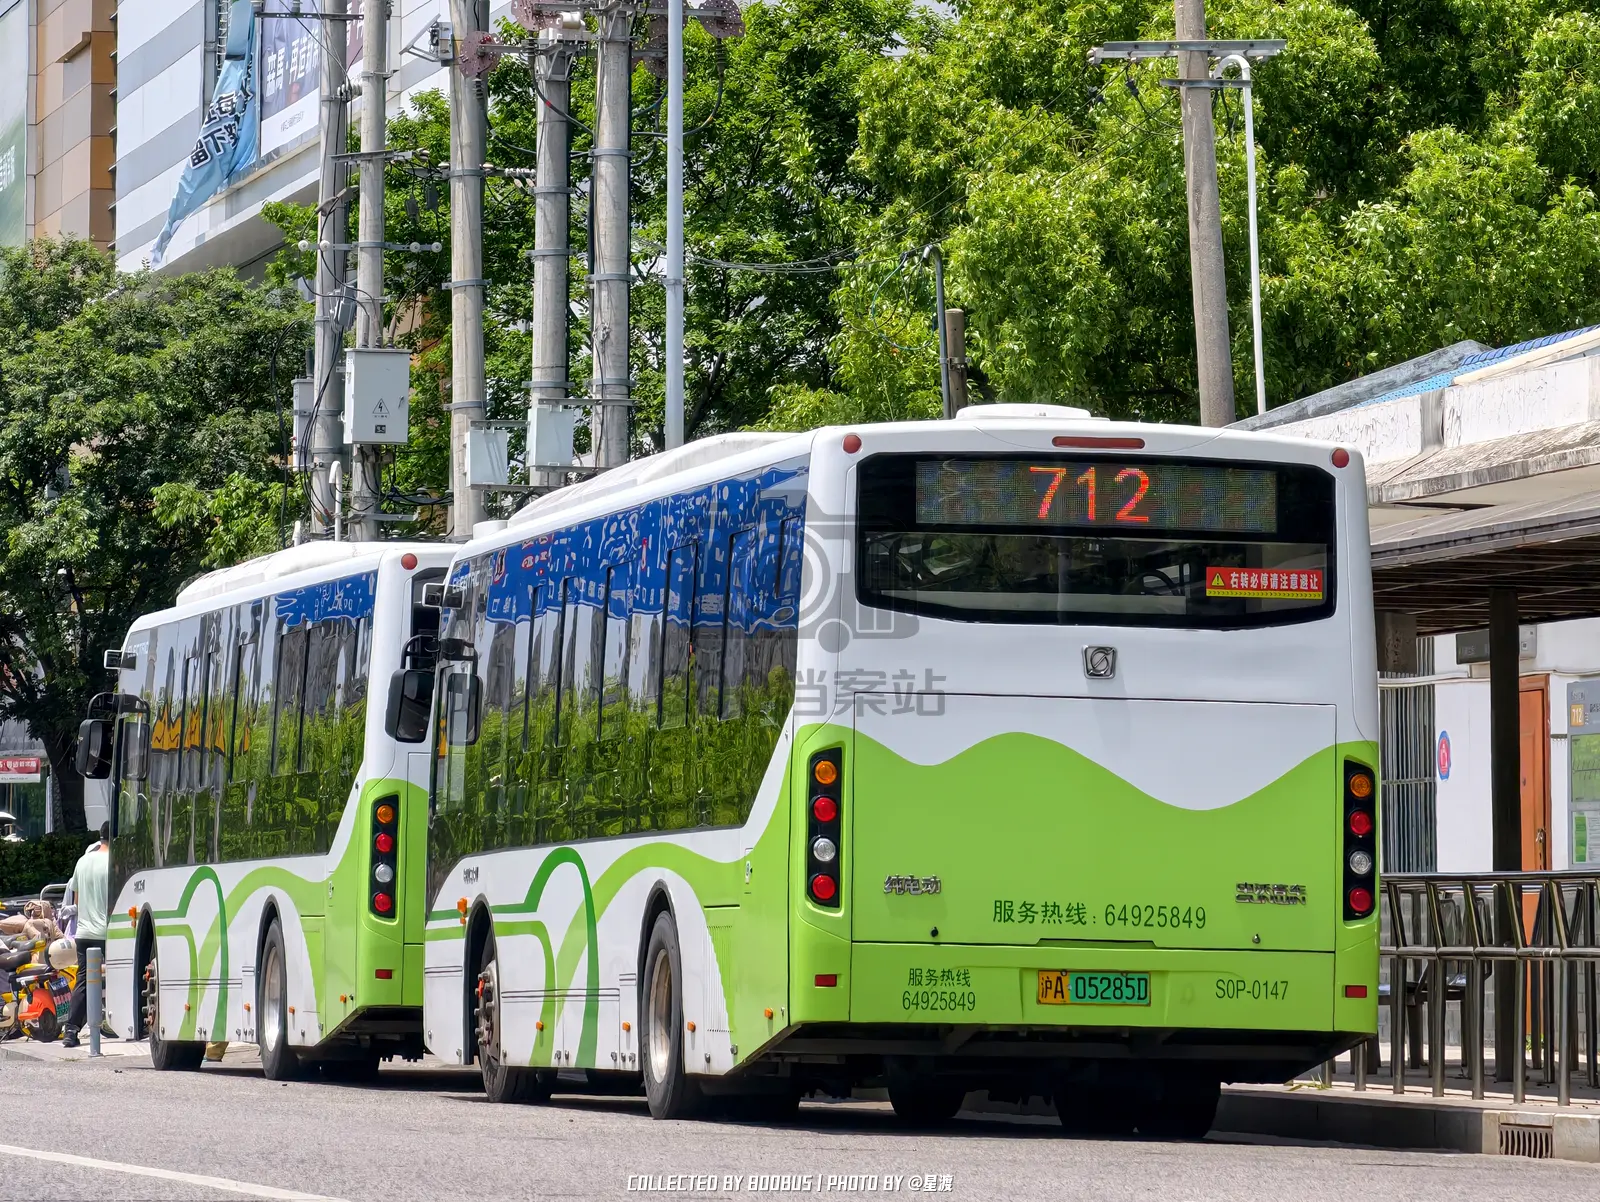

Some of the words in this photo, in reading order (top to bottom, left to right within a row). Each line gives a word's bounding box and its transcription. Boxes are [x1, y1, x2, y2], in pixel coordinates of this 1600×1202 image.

[1029, 465, 1149, 522] 712
[1230, 571, 1318, 590] 右转必停请注意避让
[884, 873, 941, 895] 纯电动
[908, 968, 971, 987] 服务热线
[902, 991, 976, 1011] 64925849
